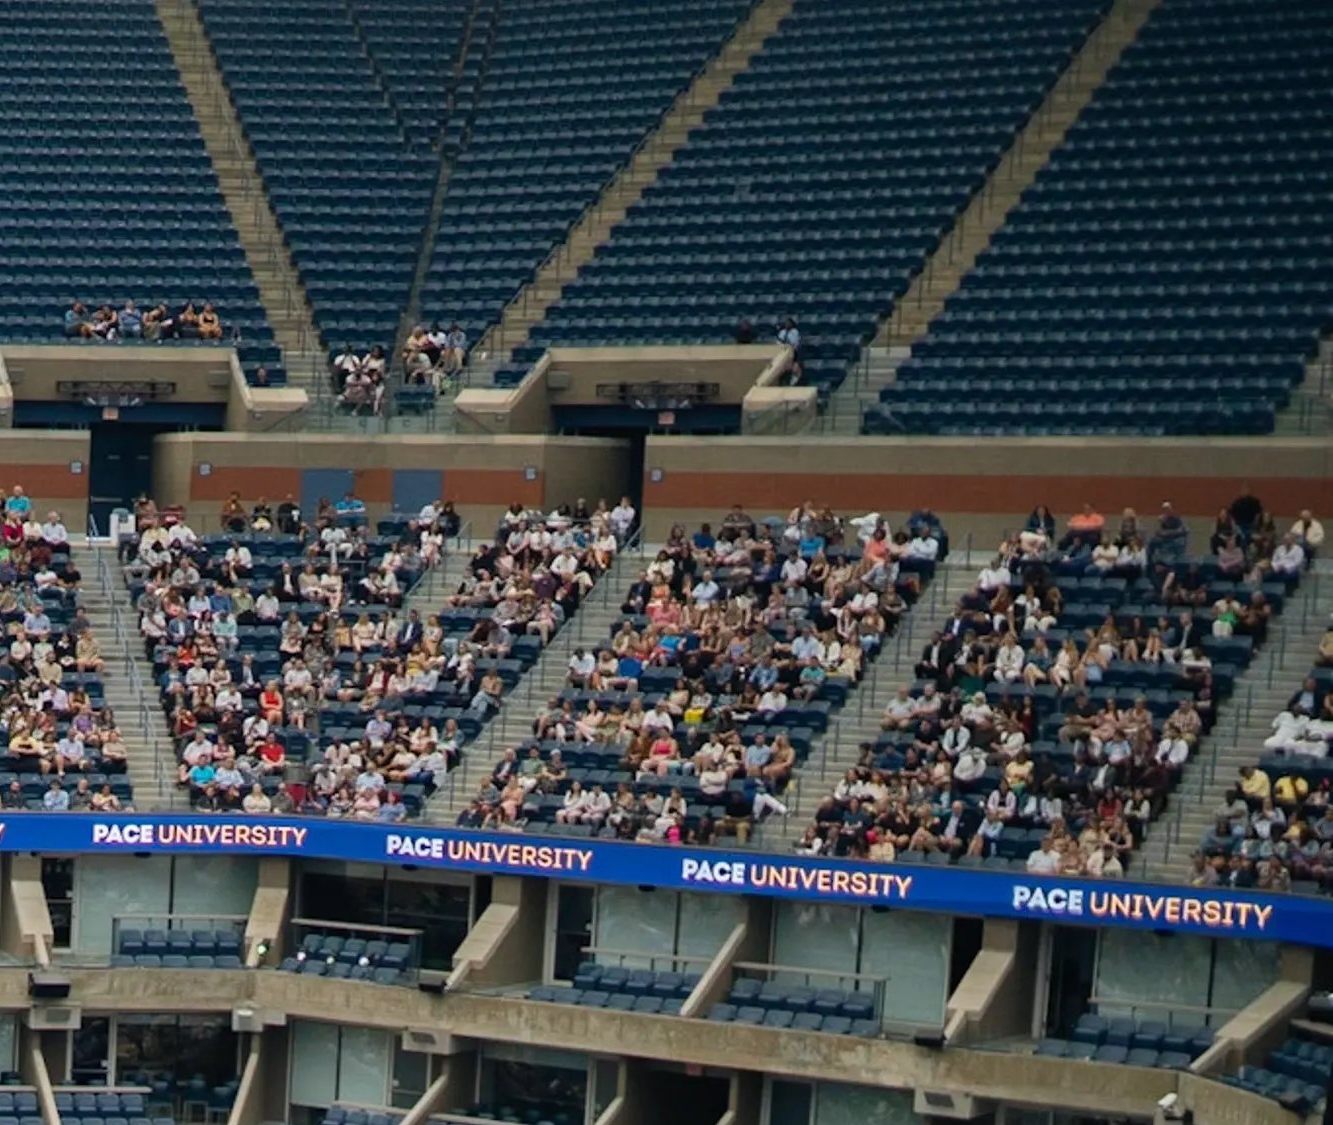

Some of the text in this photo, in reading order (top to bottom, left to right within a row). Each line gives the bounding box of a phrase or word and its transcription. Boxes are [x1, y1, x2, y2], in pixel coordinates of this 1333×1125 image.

[92, 824, 307, 847] PACE UNIVERSITY
[386, 834, 593, 871] PACE UNIVERSITY
[682, 858, 912, 899] PACE UNIVERSITY
[1013, 886, 1273, 928] PACE UNIVERSITY
